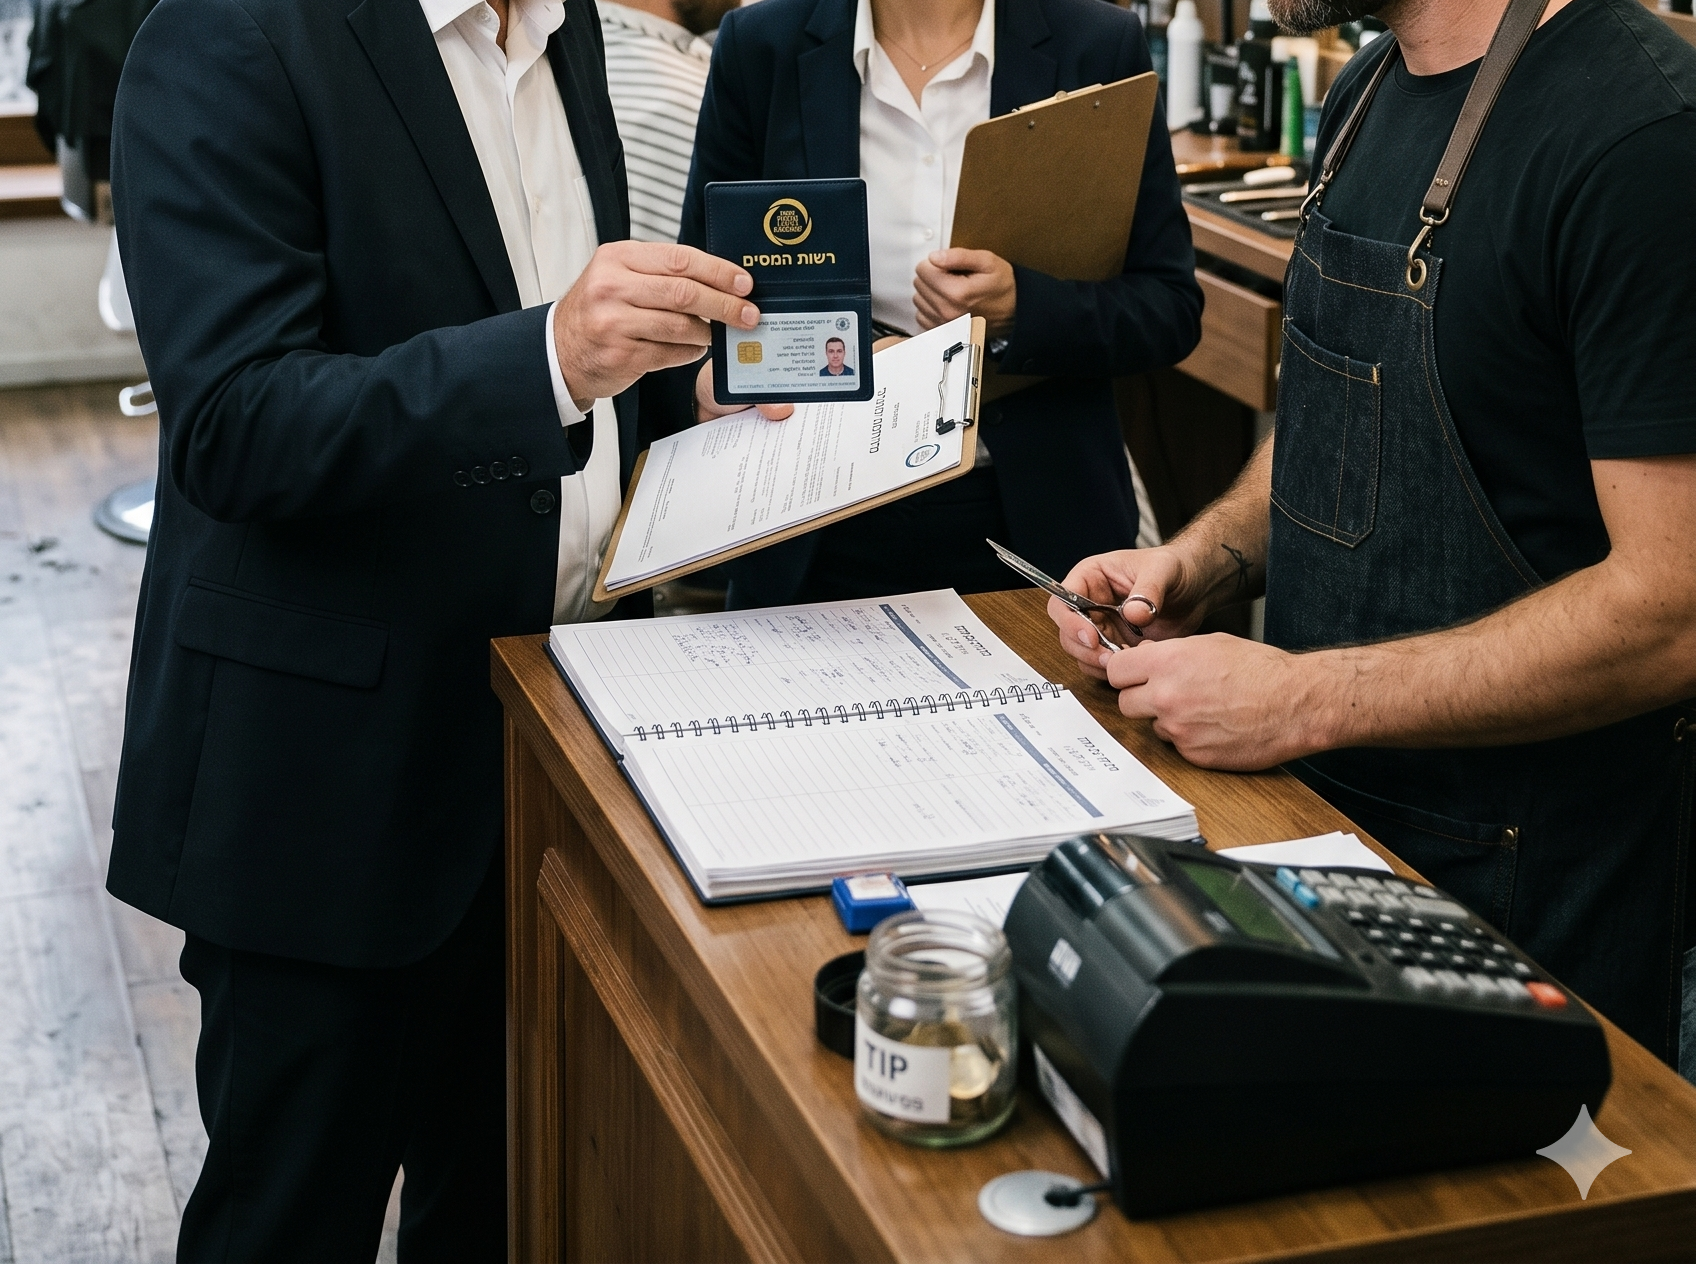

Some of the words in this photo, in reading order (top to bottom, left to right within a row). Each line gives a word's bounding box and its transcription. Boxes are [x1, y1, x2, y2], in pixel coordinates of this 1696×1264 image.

[742, 253, 793, 267] המסים
[797, 252, 836, 265] רשות
[864, 1039, 908, 1081] TIP
